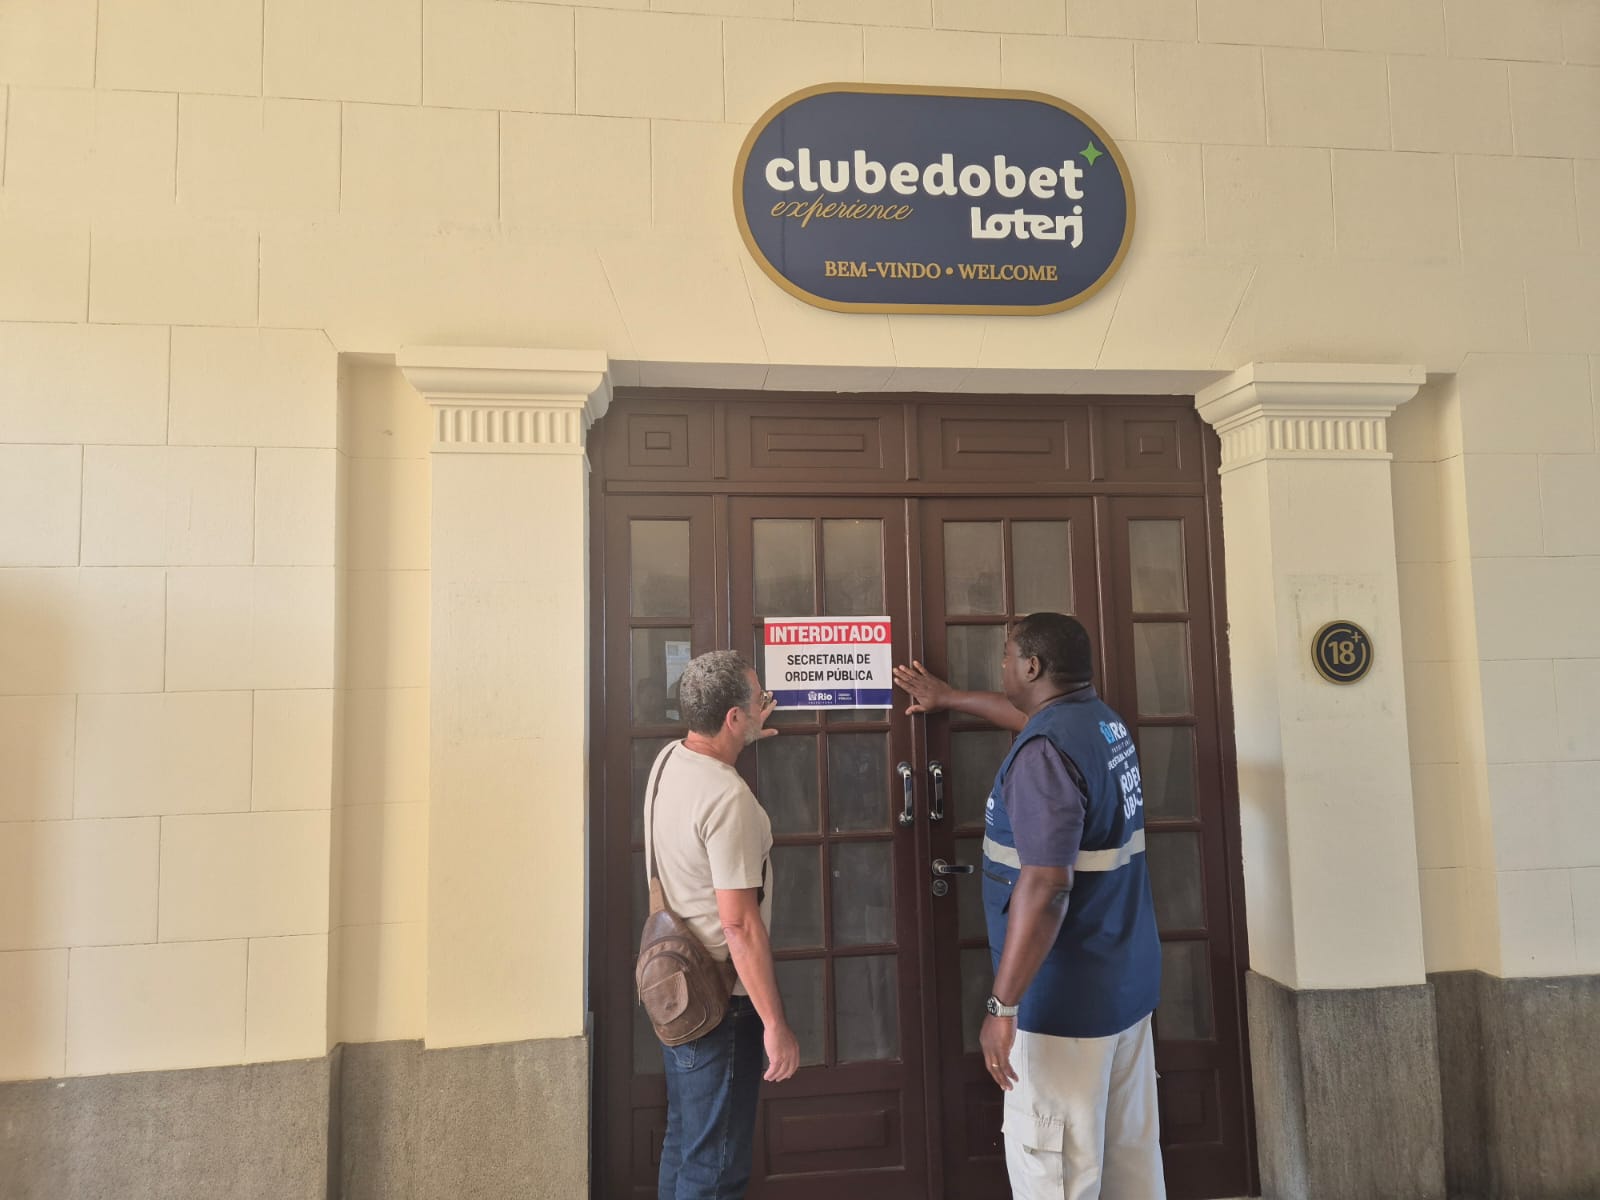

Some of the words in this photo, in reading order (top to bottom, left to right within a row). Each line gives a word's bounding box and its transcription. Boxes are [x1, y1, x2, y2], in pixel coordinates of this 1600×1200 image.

[765, 148, 1084, 200] clubedobet
[770, 193, 914, 228] experience
[971, 206, 1084, 248] Loterj
[824, 260, 942, 280] BEM-VINDO
[959, 264, 1058, 282] WELCOME
[769, 624, 887, 643] INTERDITADO
[787, 653, 854, 666] SECRETARIA
[856, 653, 871, 665] DE
[785, 670, 824, 682] ORDEM
[826, 667, 874, 682] PÚBLICA
[817, 692, 833, 701] Rio
